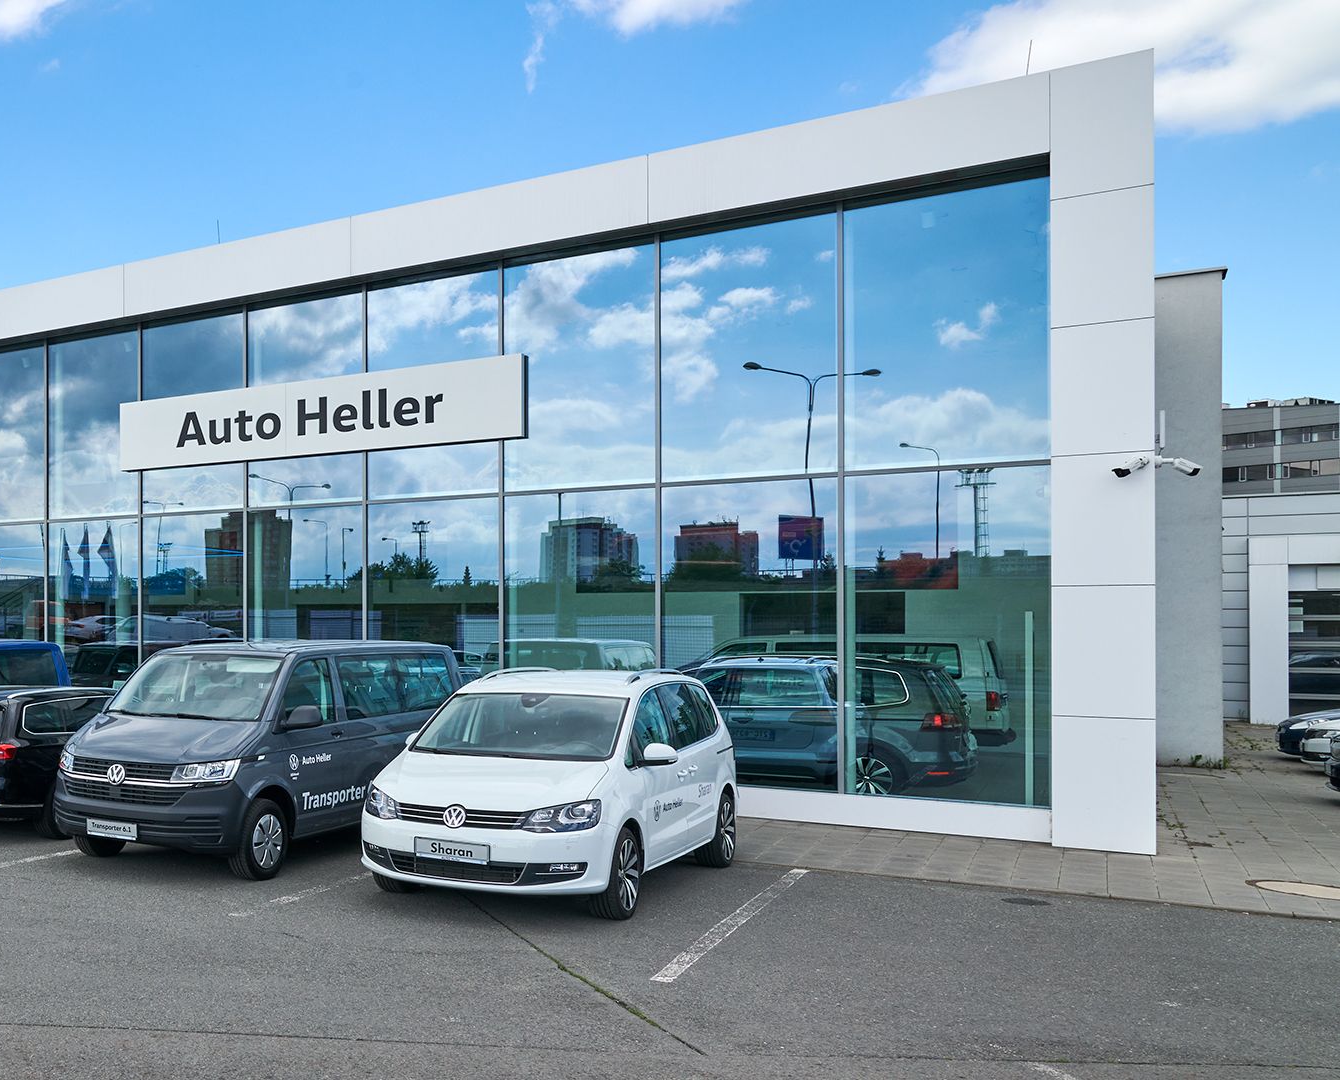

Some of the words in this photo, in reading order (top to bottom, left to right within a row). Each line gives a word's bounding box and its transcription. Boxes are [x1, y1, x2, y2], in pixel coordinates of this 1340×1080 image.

[176, 410, 281, 448] Auto
[297, 387, 443, 437] Heller
[302, 756, 315, 765] Auto
[316, 753, 332, 763] Heller
[302, 785, 366, 810] Transporter
[91, 822, 122, 831] Transporter
[431, 842, 473, 857] Sharan
